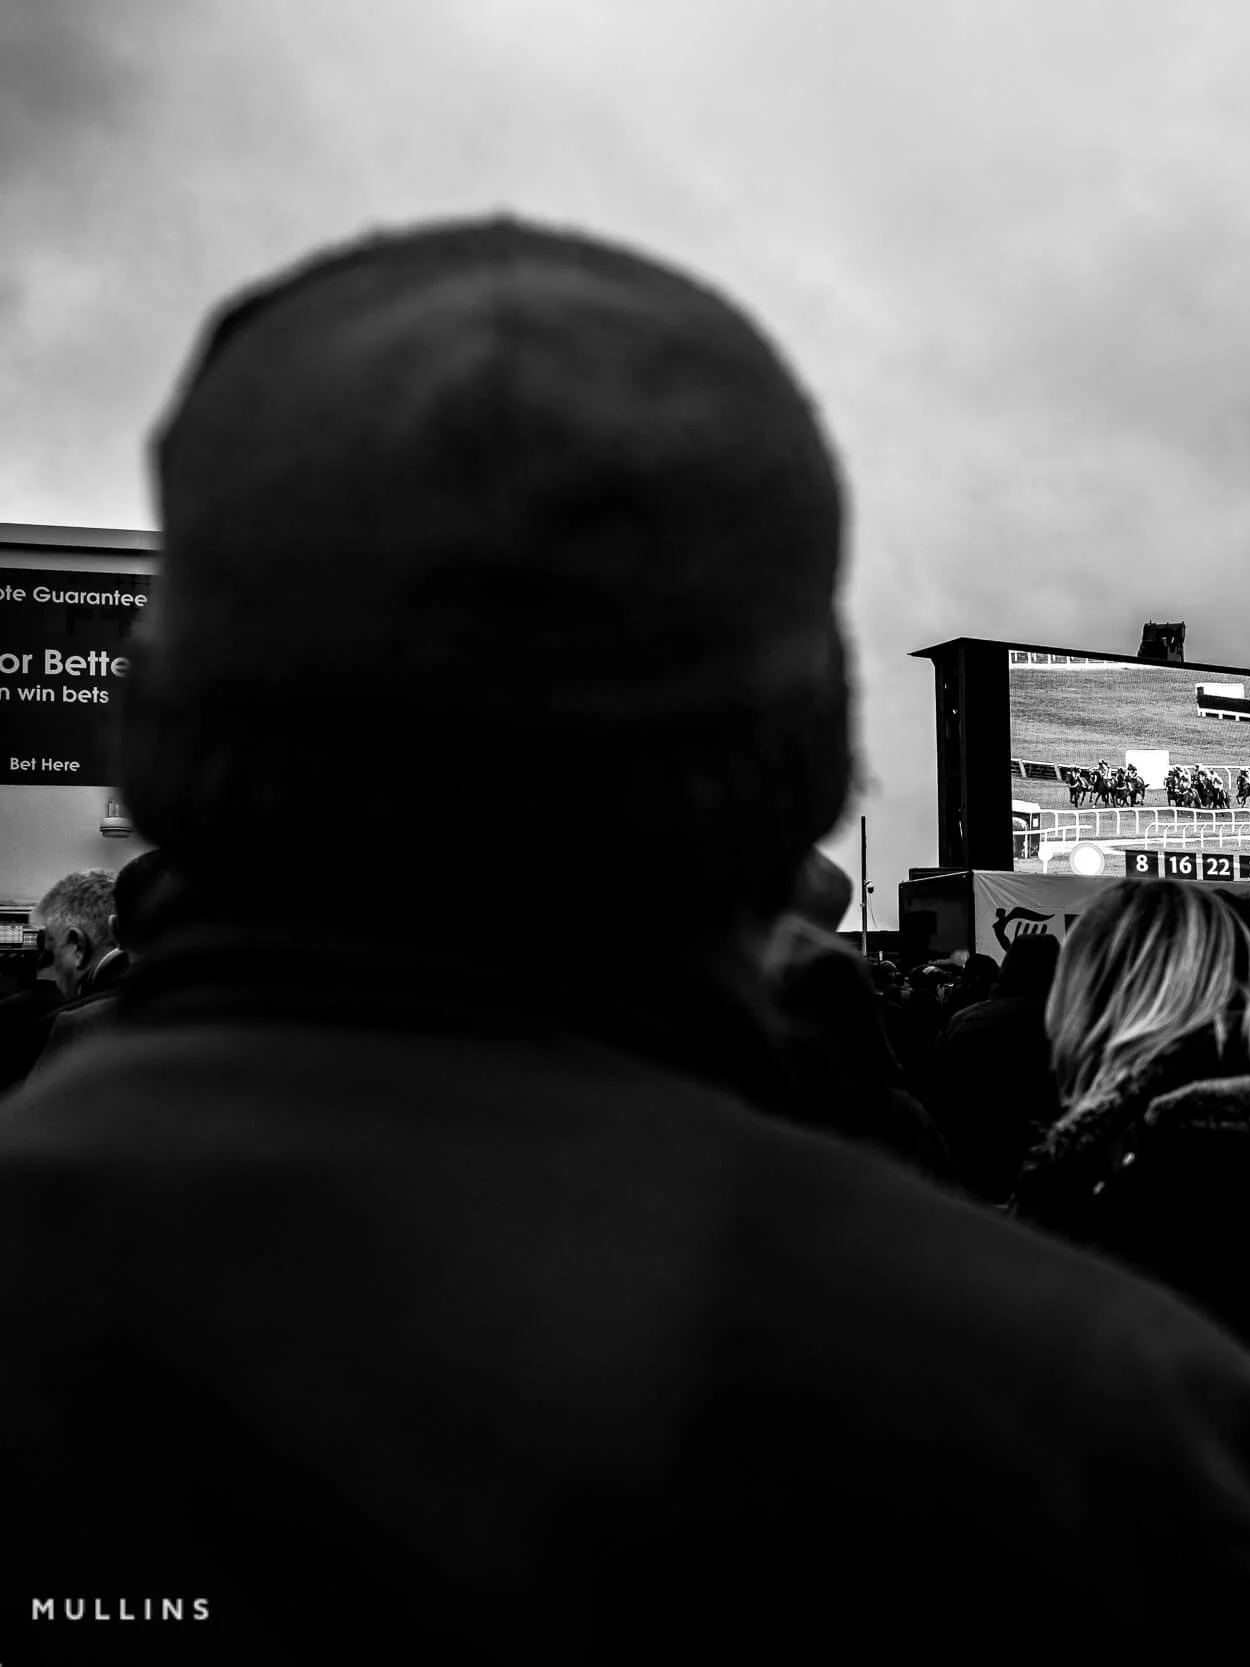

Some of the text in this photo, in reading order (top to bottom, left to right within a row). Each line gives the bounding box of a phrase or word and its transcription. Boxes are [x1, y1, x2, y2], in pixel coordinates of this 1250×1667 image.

[33, 586, 148, 607] Guarantee
[0, 653, 33, 674] or
[17, 684, 55, 702] win
[62, 685, 110, 703] bets
[10, 757, 80, 772] Bet Here
[1136, 854, 1149, 872] 8
[1169, 856, 1192, 874] 16
[1206, 858, 1231, 876] 22
